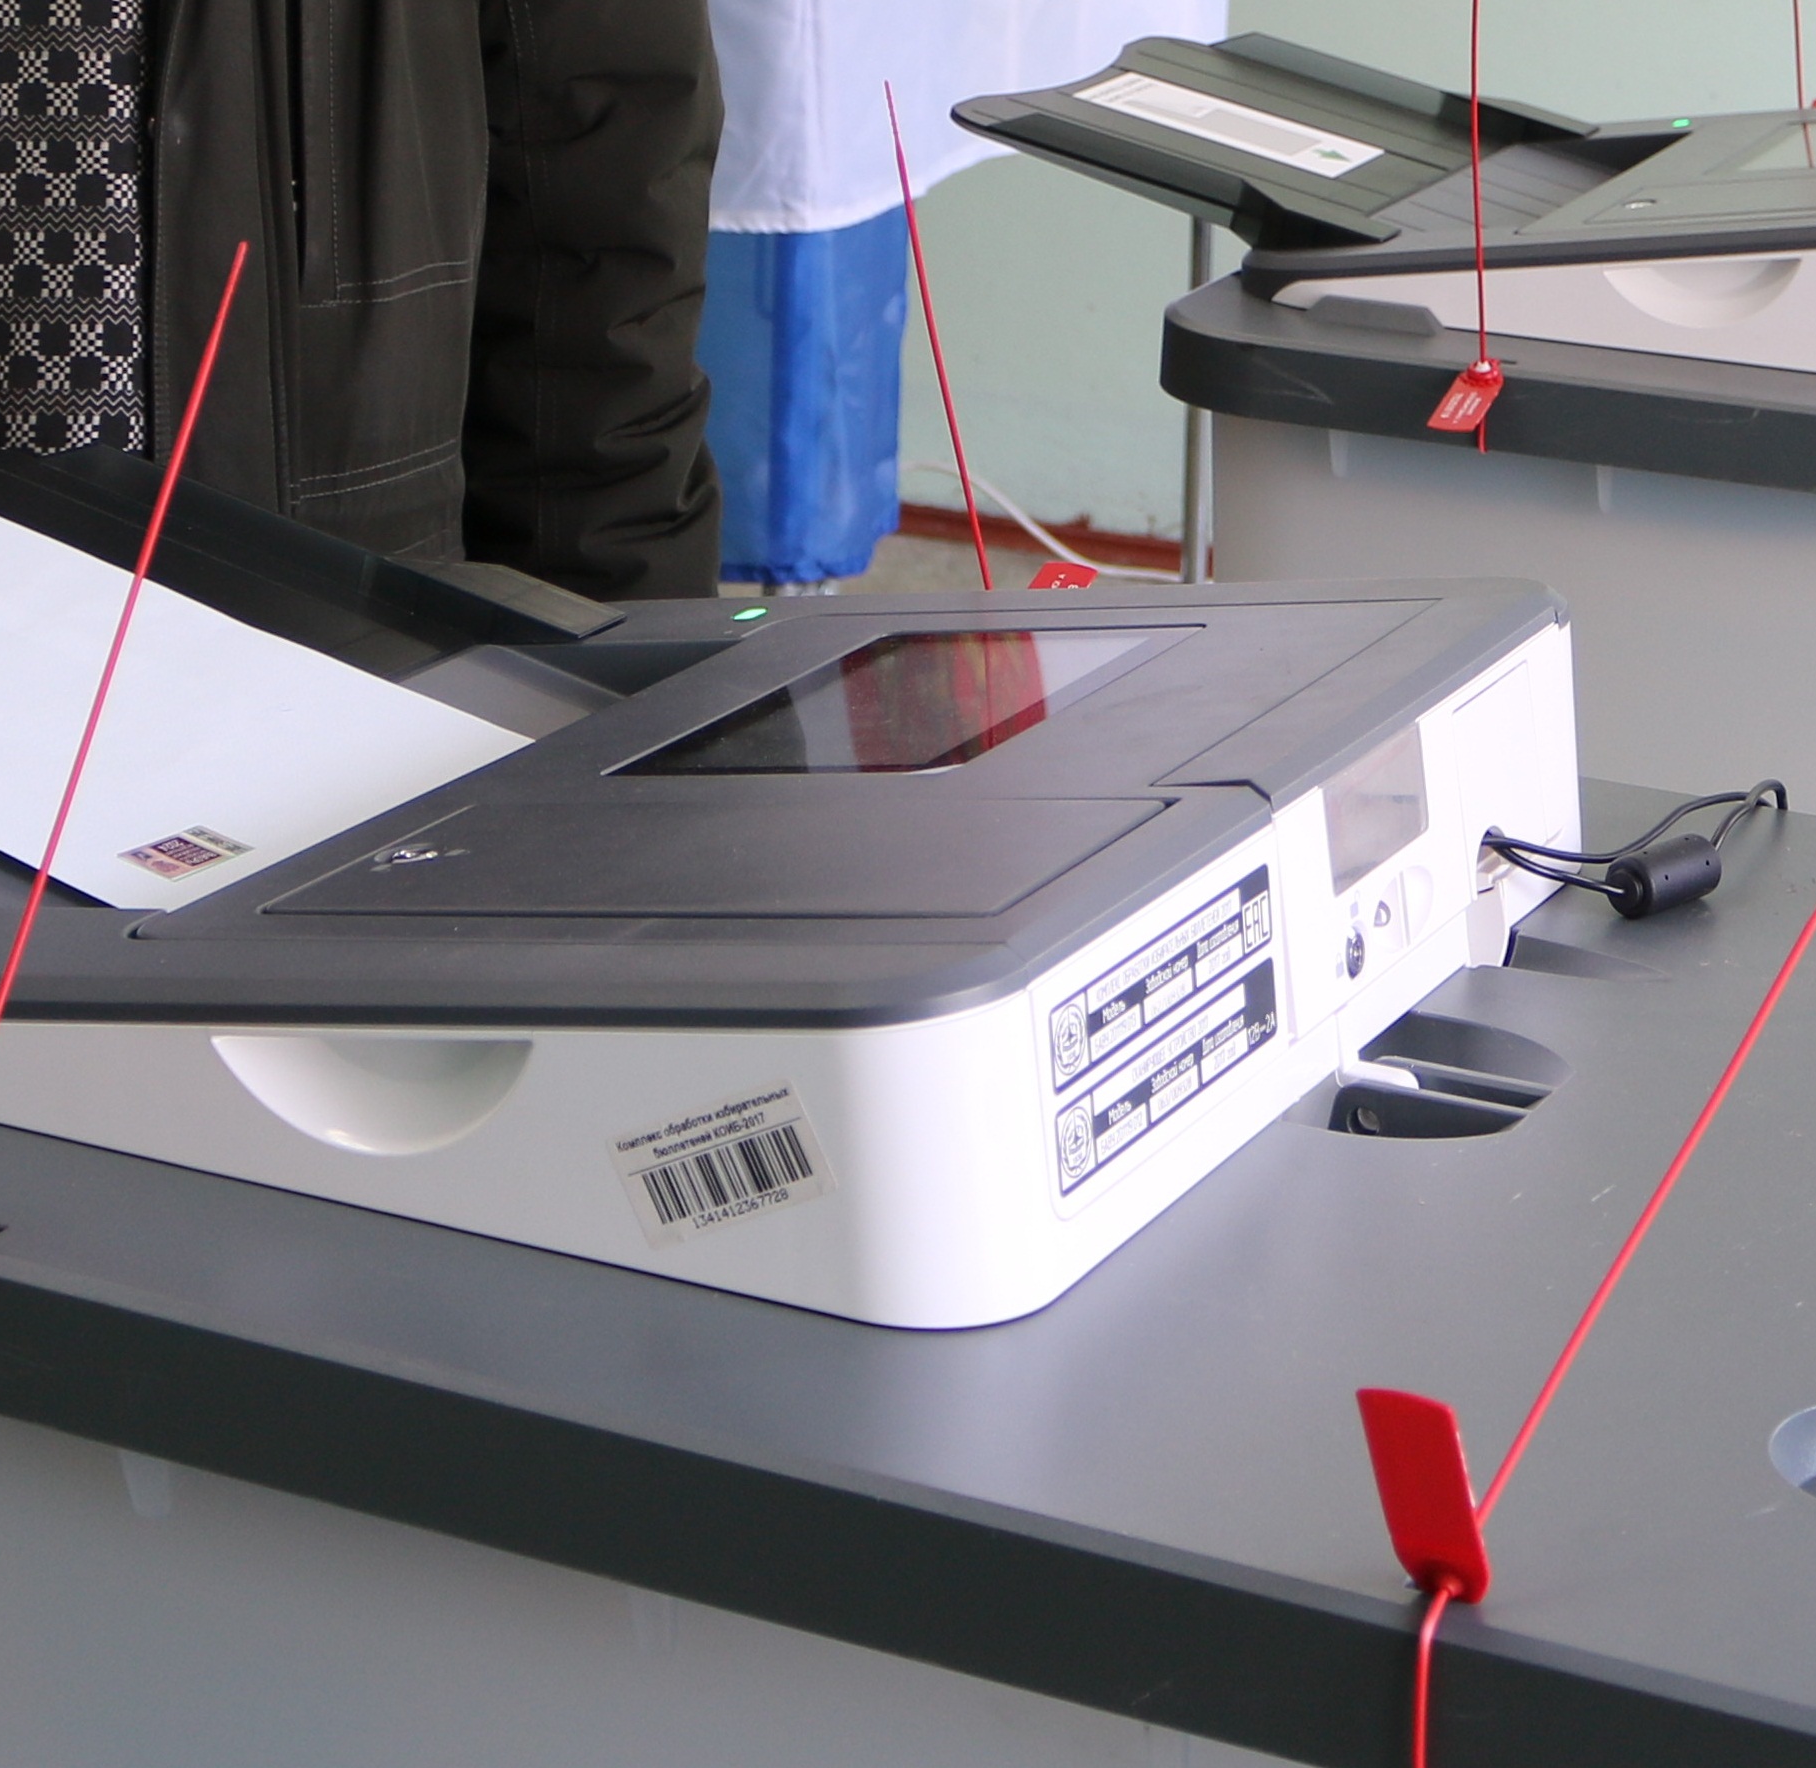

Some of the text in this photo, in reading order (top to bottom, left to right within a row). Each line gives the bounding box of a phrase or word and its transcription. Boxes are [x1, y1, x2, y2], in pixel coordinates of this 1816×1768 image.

[1244, 895, 1269, 949] EAC
[615, 1087, 790, 1153] Комплекс обработки избирательных
[712, 1112, 765, 1141] КОИБ-2017
[691, 1189, 790, 1230] 1341412367728
